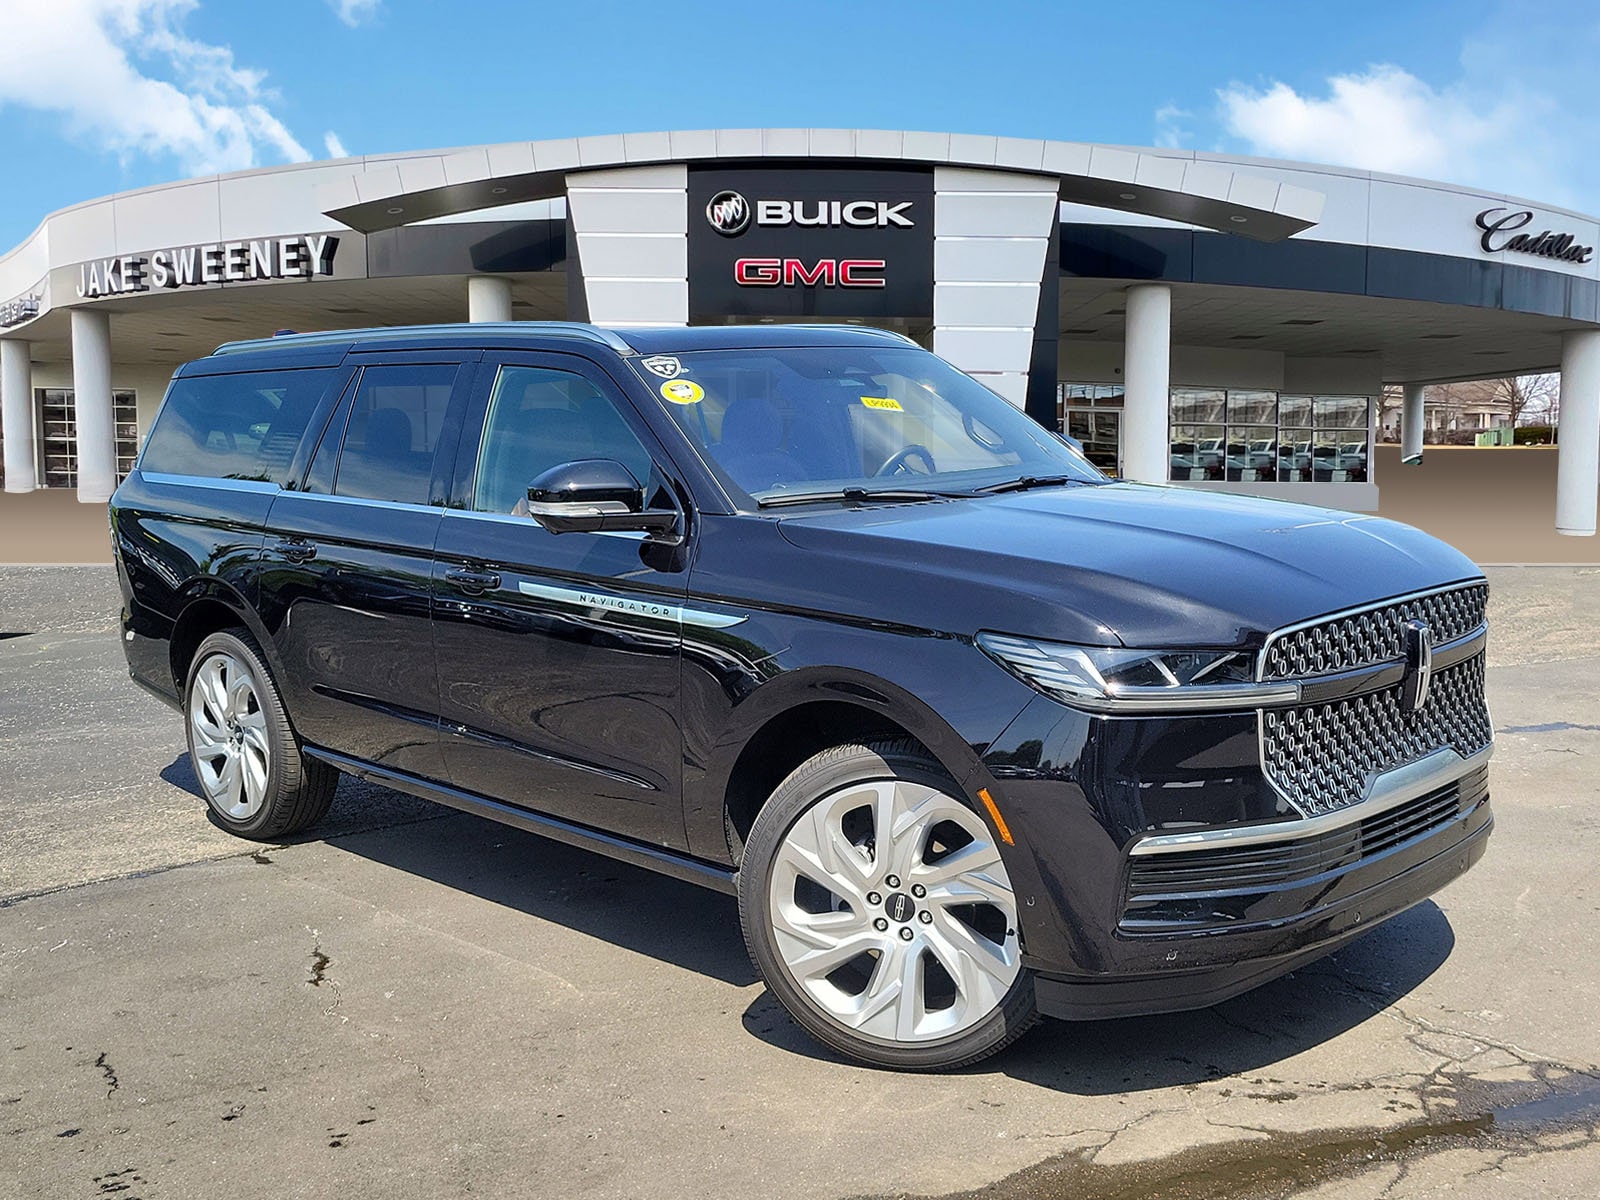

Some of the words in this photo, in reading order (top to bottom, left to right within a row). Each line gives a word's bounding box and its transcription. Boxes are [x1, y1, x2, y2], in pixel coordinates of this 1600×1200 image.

[757, 200, 914, 227] BUICK
[1475, 207, 1593, 264] Cadillac
[76, 256, 141, 298] JAKE
[152, 235, 332, 288] SWEENEY
[735, 258, 886, 287] GMC
[580, 594, 670, 616] NAVIGATOR
